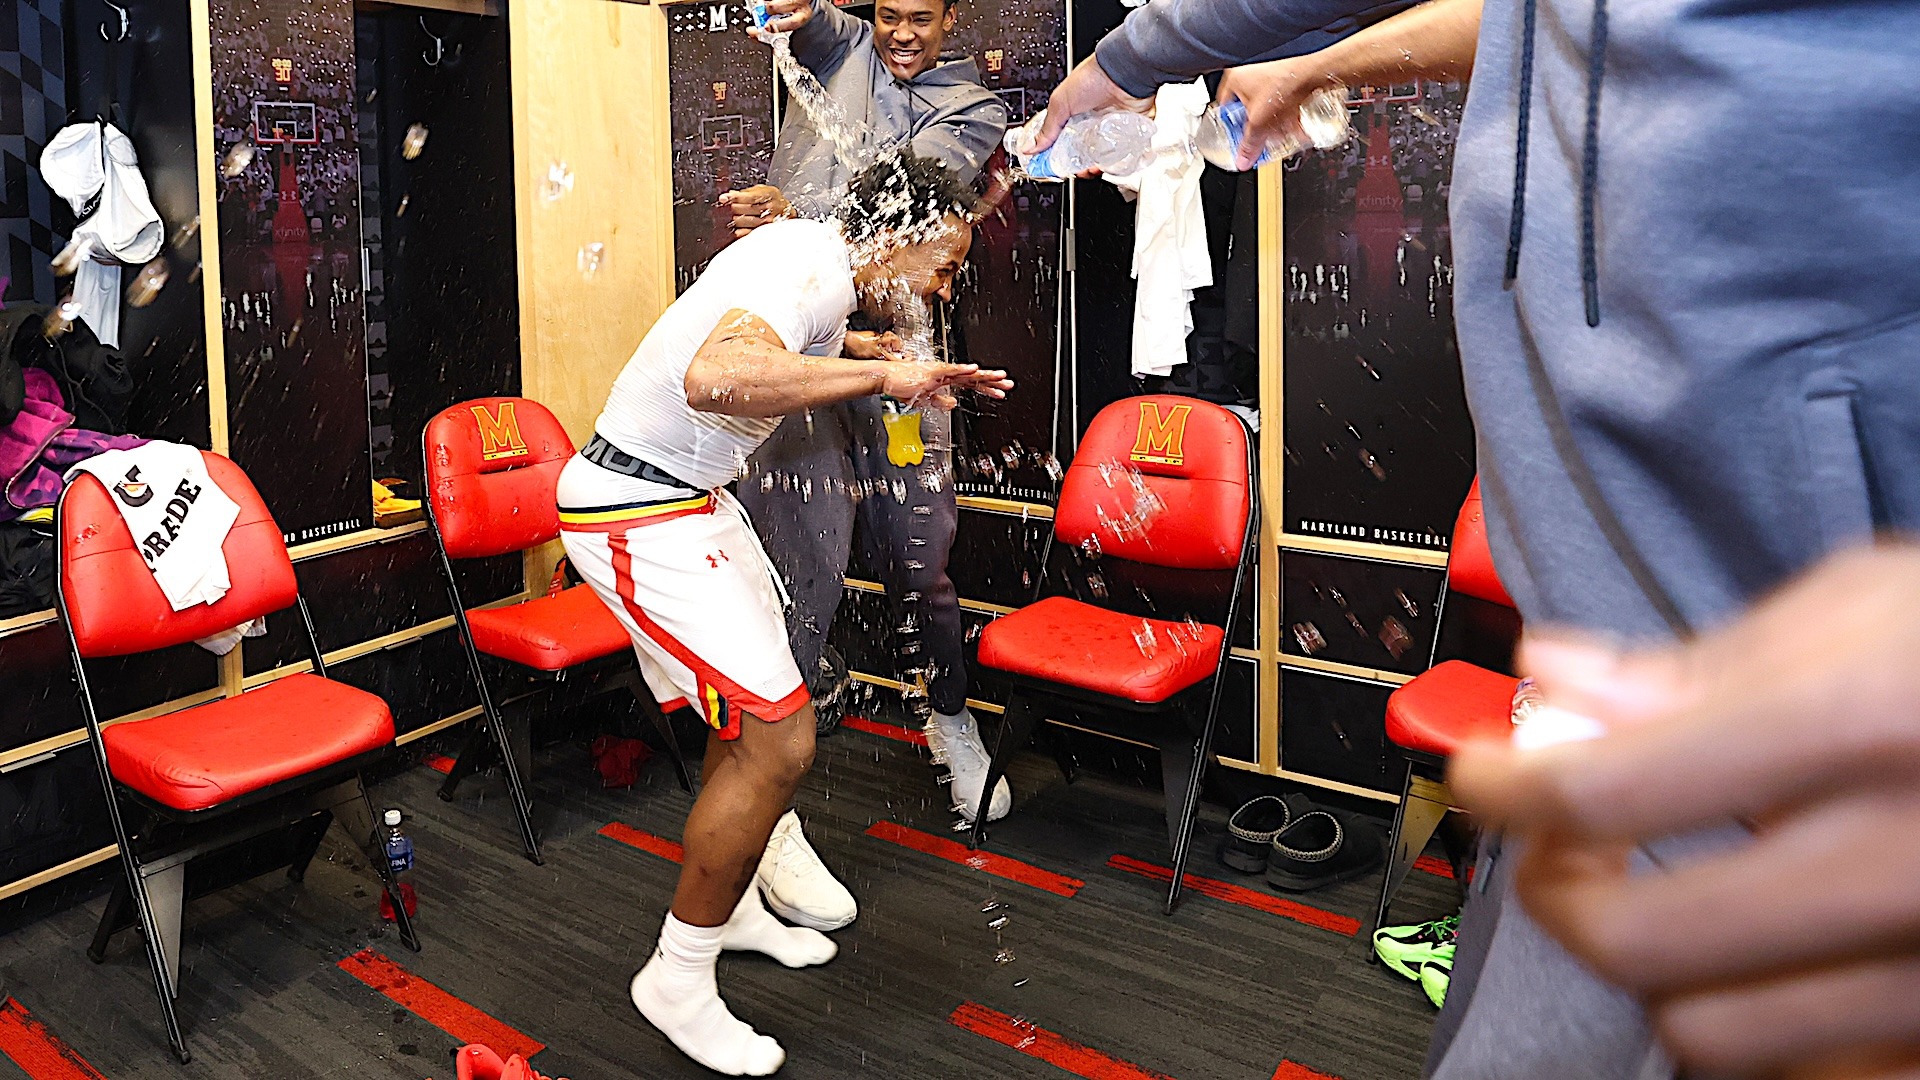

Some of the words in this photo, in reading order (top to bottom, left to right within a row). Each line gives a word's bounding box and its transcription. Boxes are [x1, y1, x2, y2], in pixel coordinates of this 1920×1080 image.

[709, 4, 728, 32] M
[275, 67, 292, 81] 30
[987, 58, 1002, 71] 30
[470, 402, 527, 453] M
[1131, 402, 1193, 457] M
[143, 478, 202, 573] RADE
[302, 518, 361, 540] BASKETBALL
[1301, 520, 1366, 537] MARYLAND
[1374, 528, 1448, 546] BASKETBAL
